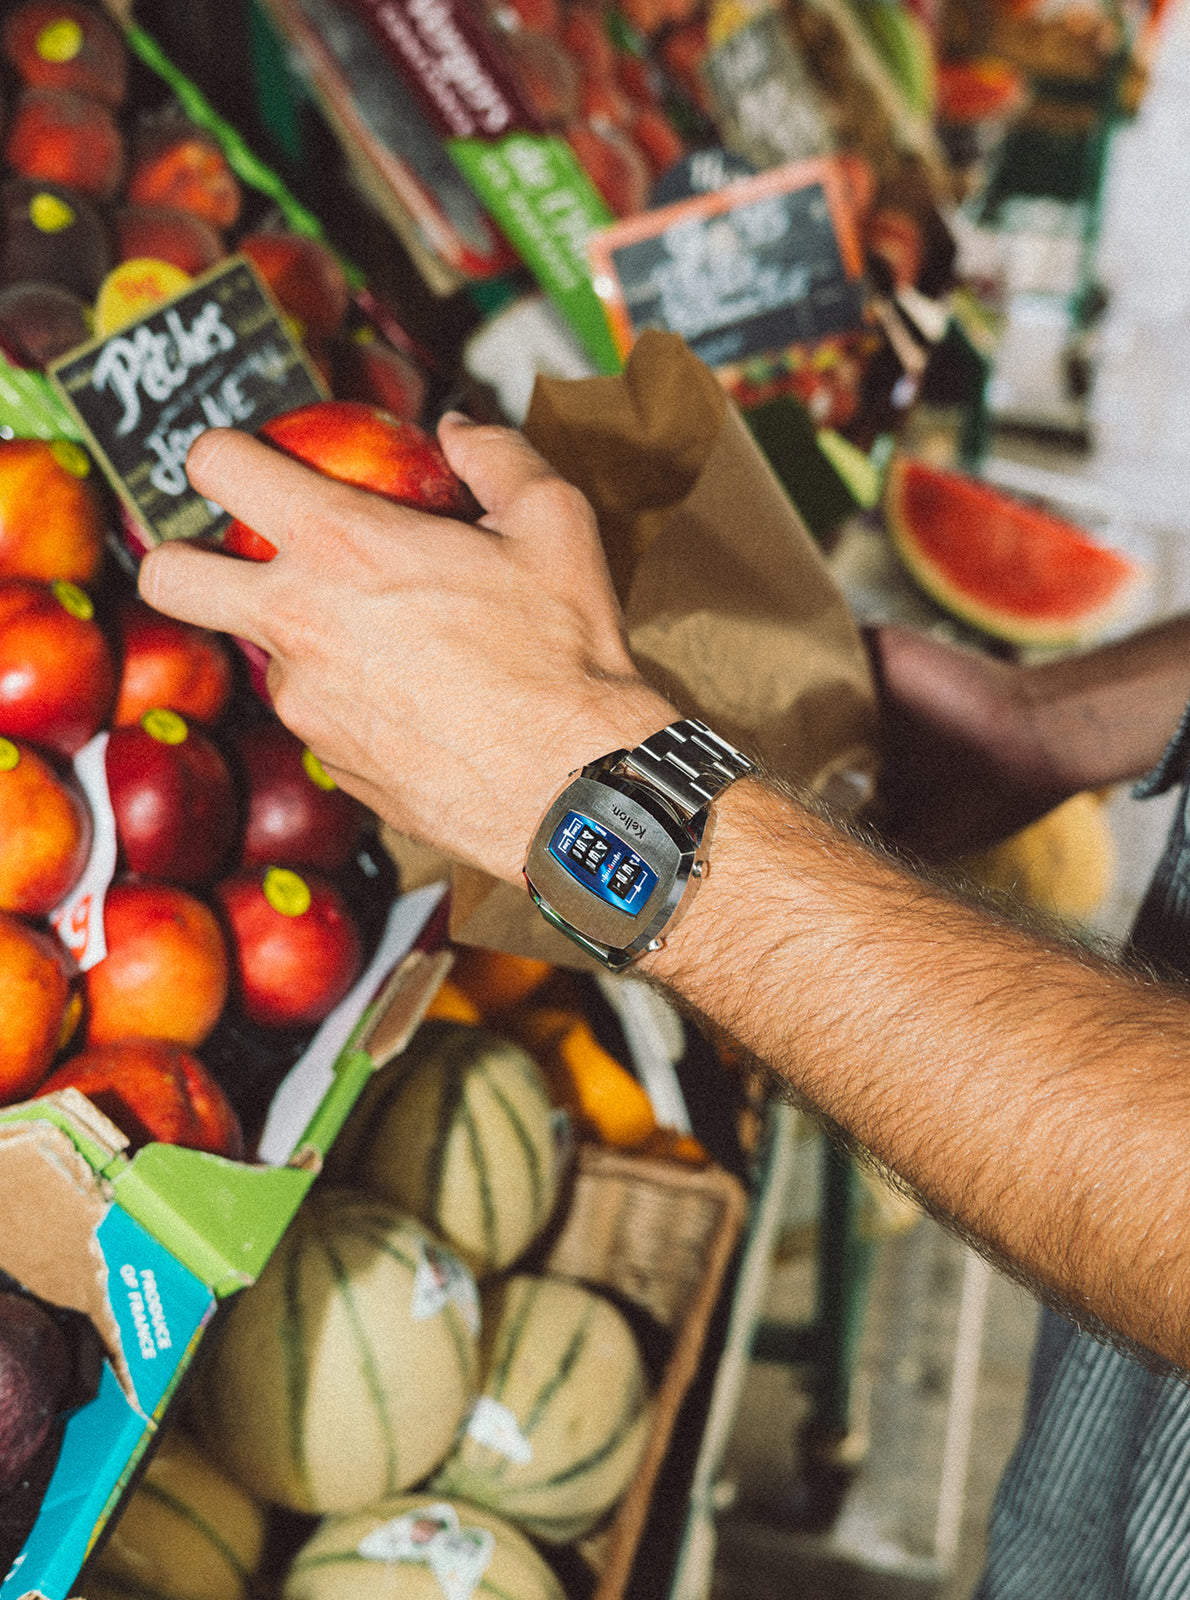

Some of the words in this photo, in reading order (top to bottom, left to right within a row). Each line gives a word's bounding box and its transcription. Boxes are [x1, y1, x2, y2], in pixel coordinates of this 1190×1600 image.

[120, 1264, 139, 1289] OF
[140, 1269, 172, 1350] PRODUCE
[127, 1291, 157, 1360] FRANCE
